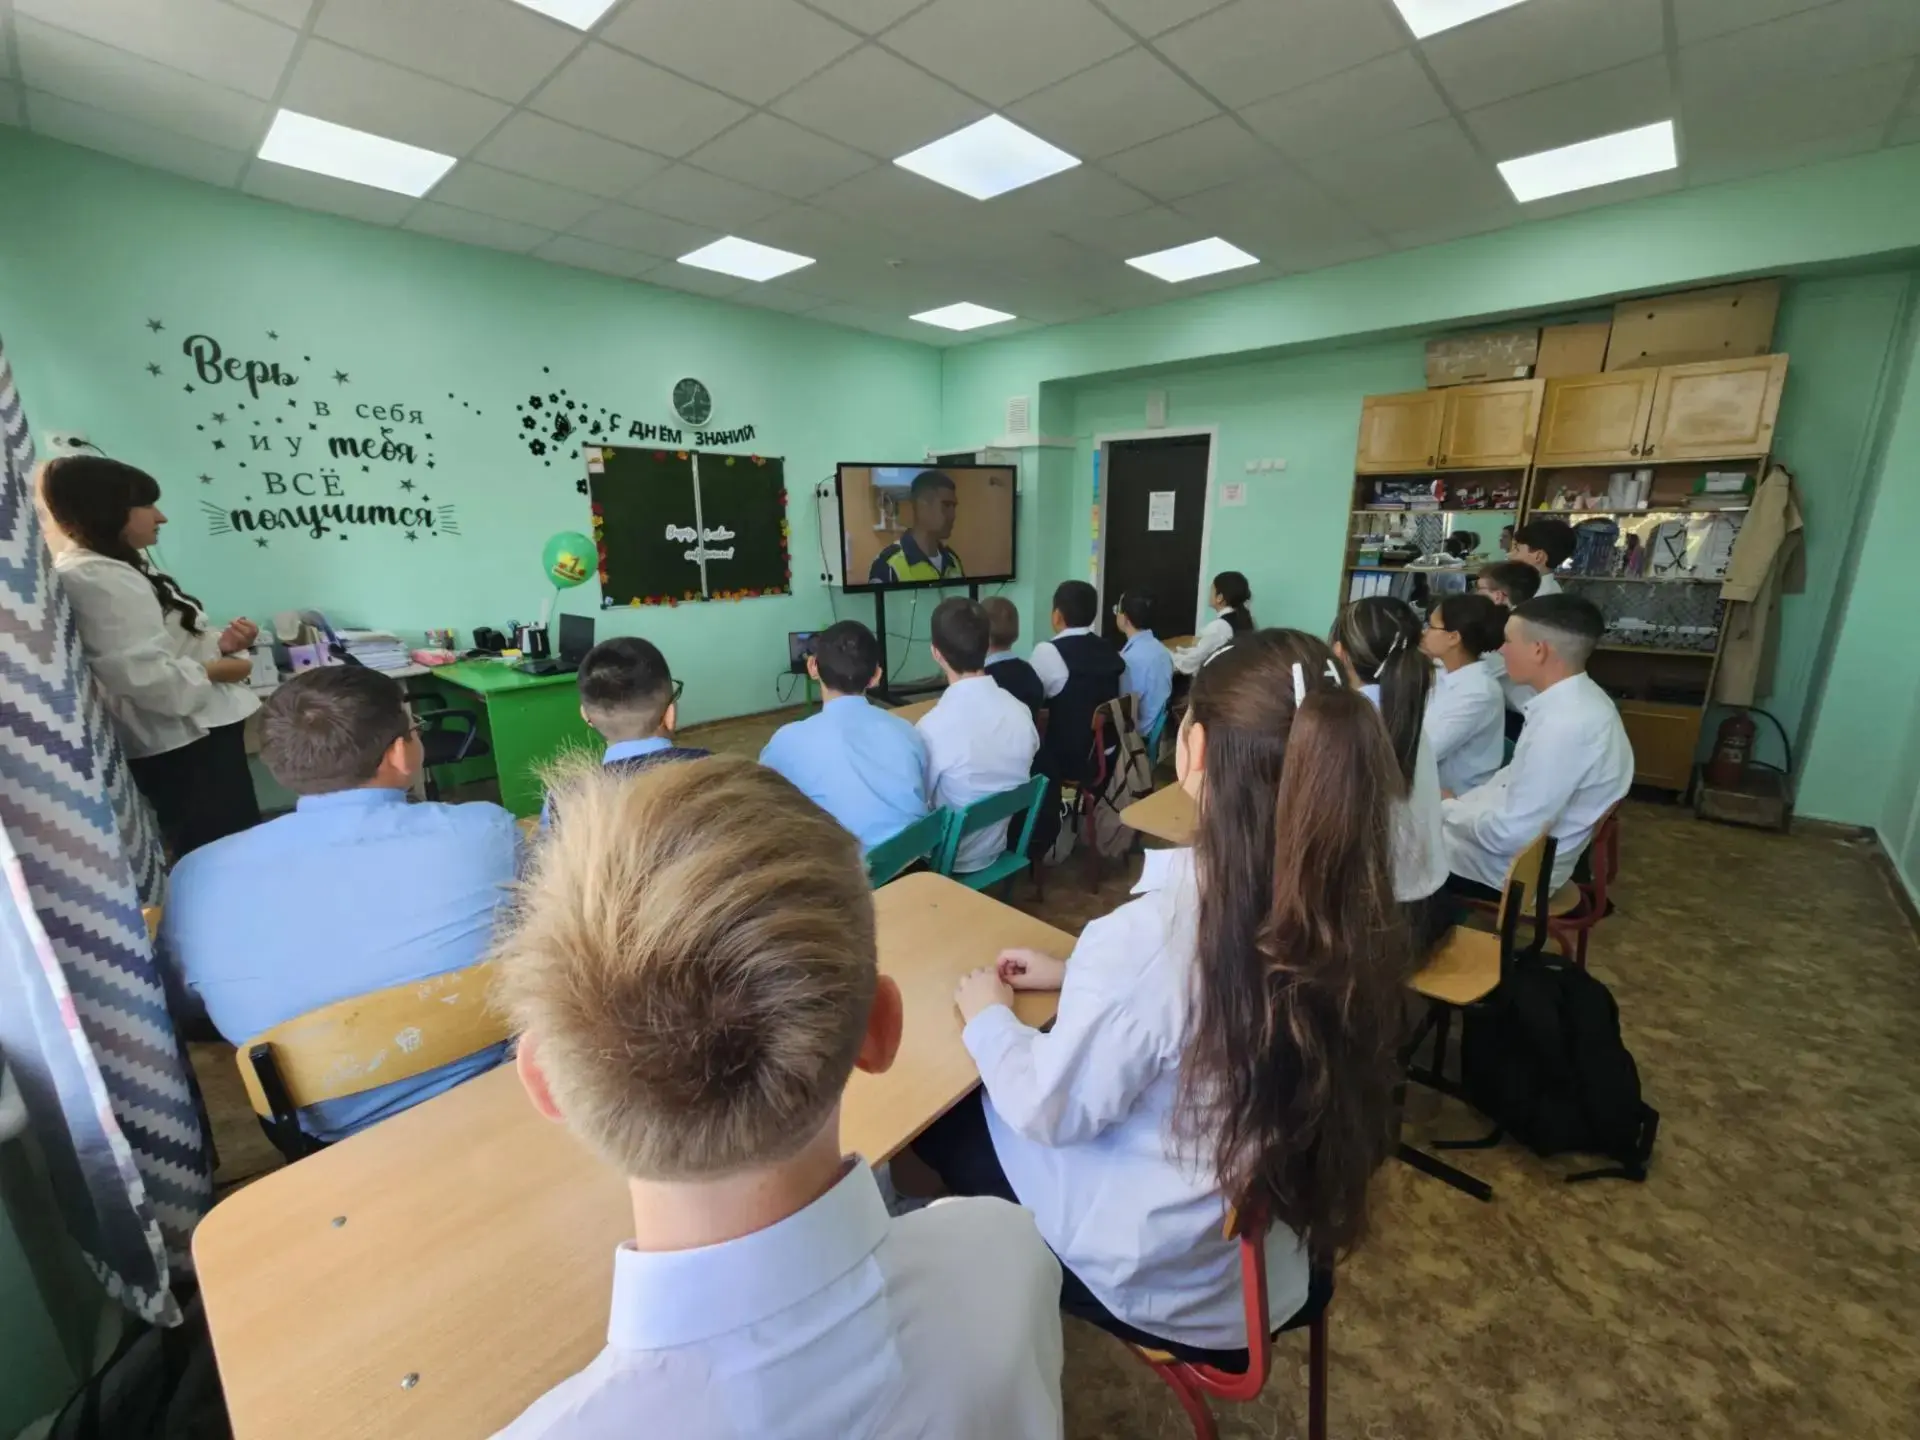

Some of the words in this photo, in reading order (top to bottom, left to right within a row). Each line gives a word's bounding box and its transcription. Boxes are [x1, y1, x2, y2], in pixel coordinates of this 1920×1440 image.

[183, 334, 299, 400] Верь
[313, 400, 331, 417] в
[355, 402, 424, 424] себя
[250, 434, 272, 452] и
[285, 436, 302, 457] у
[328, 426, 417, 464] тебя
[629, 420, 682, 444] ДНЁМ
[694, 424, 756, 446] ЗНАНИЙ
[262, 468, 345, 497] ВСЁ
[230, 504, 436, 540] получится
